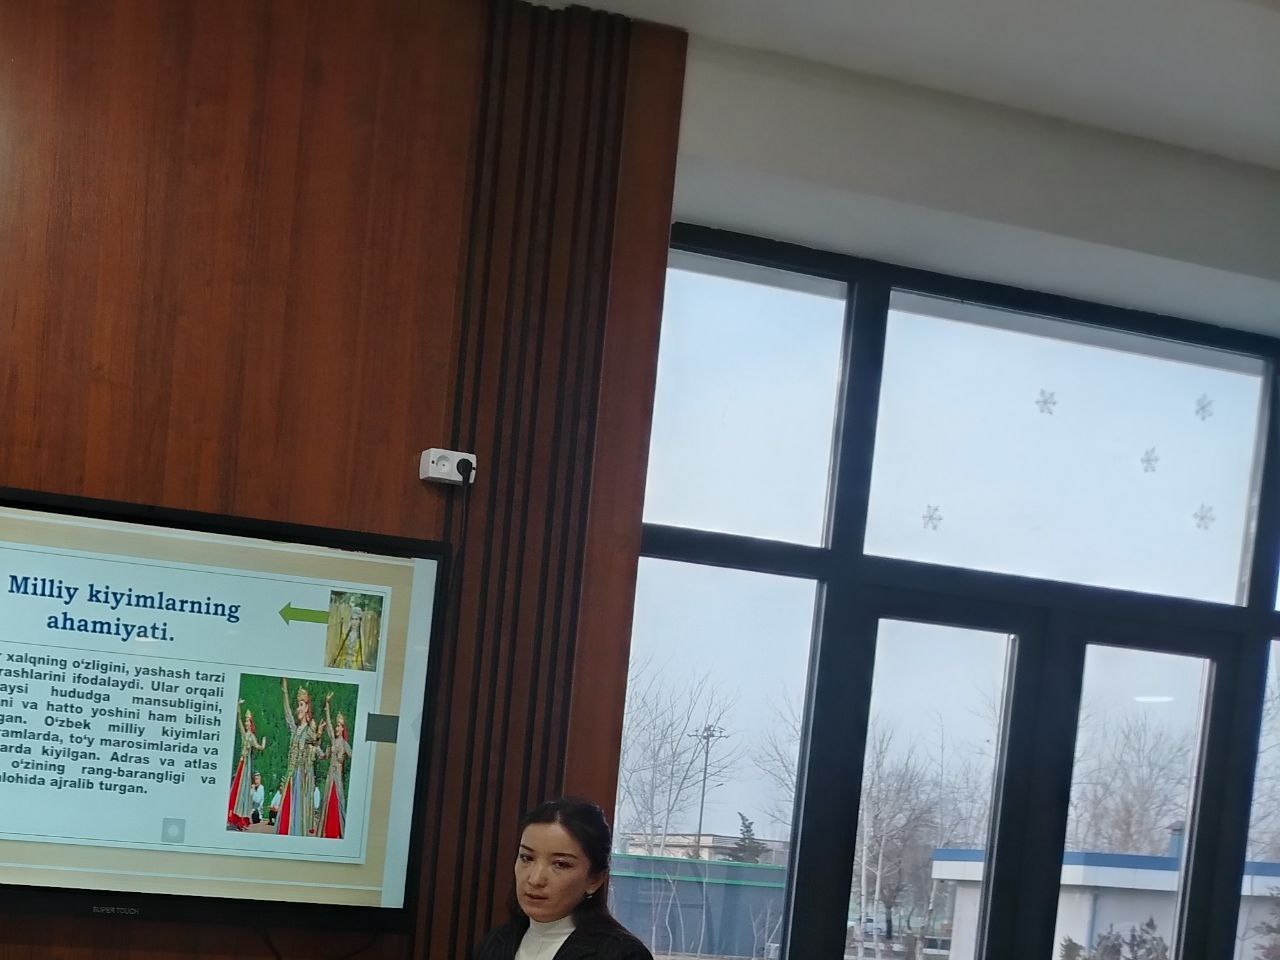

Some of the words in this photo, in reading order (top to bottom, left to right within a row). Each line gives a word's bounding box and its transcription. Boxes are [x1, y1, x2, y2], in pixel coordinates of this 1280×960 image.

[7, 574, 80, 606] Milliy
[86, 583, 242, 624] kiyimlarning
[46, 611, 175, 643] ahamiyati.
[5, 651, 68, 670] xalqning
[133, 665, 191, 679] yashash
[194, 669, 225, 683] tarzi
[71, 672, 144, 691] ifodalaydi.
[150, 679, 180, 693] Ular
[184, 685, 224, 699] orqali
[49, 685, 110, 704] hududga
[131, 695, 222, 714] mansubligini,
[20, 700, 38, 710] va
[45, 700, 83, 714] hatto
[89, 706, 140, 719] yoshini
[147, 709, 177, 723] ham
[184, 712, 221, 727] bilish
[107, 721, 146, 737] milliy
[160, 725, 220, 741] kiyimlari
[40, 742, 100, 761] kiyilgan.
[108, 750, 150, 765] Adras
[158, 757, 175, 767] va
[183, 757, 217, 770] atlas
[98, 737, 198, 754] marosimlarida
[202, 746, 218, 756] va
[48, 775, 94, 790] ajralib
[97, 779, 147, 795] turgan.
[80, 765, 186, 784] rang-barangligi
[199, 775, 216, 784] va
